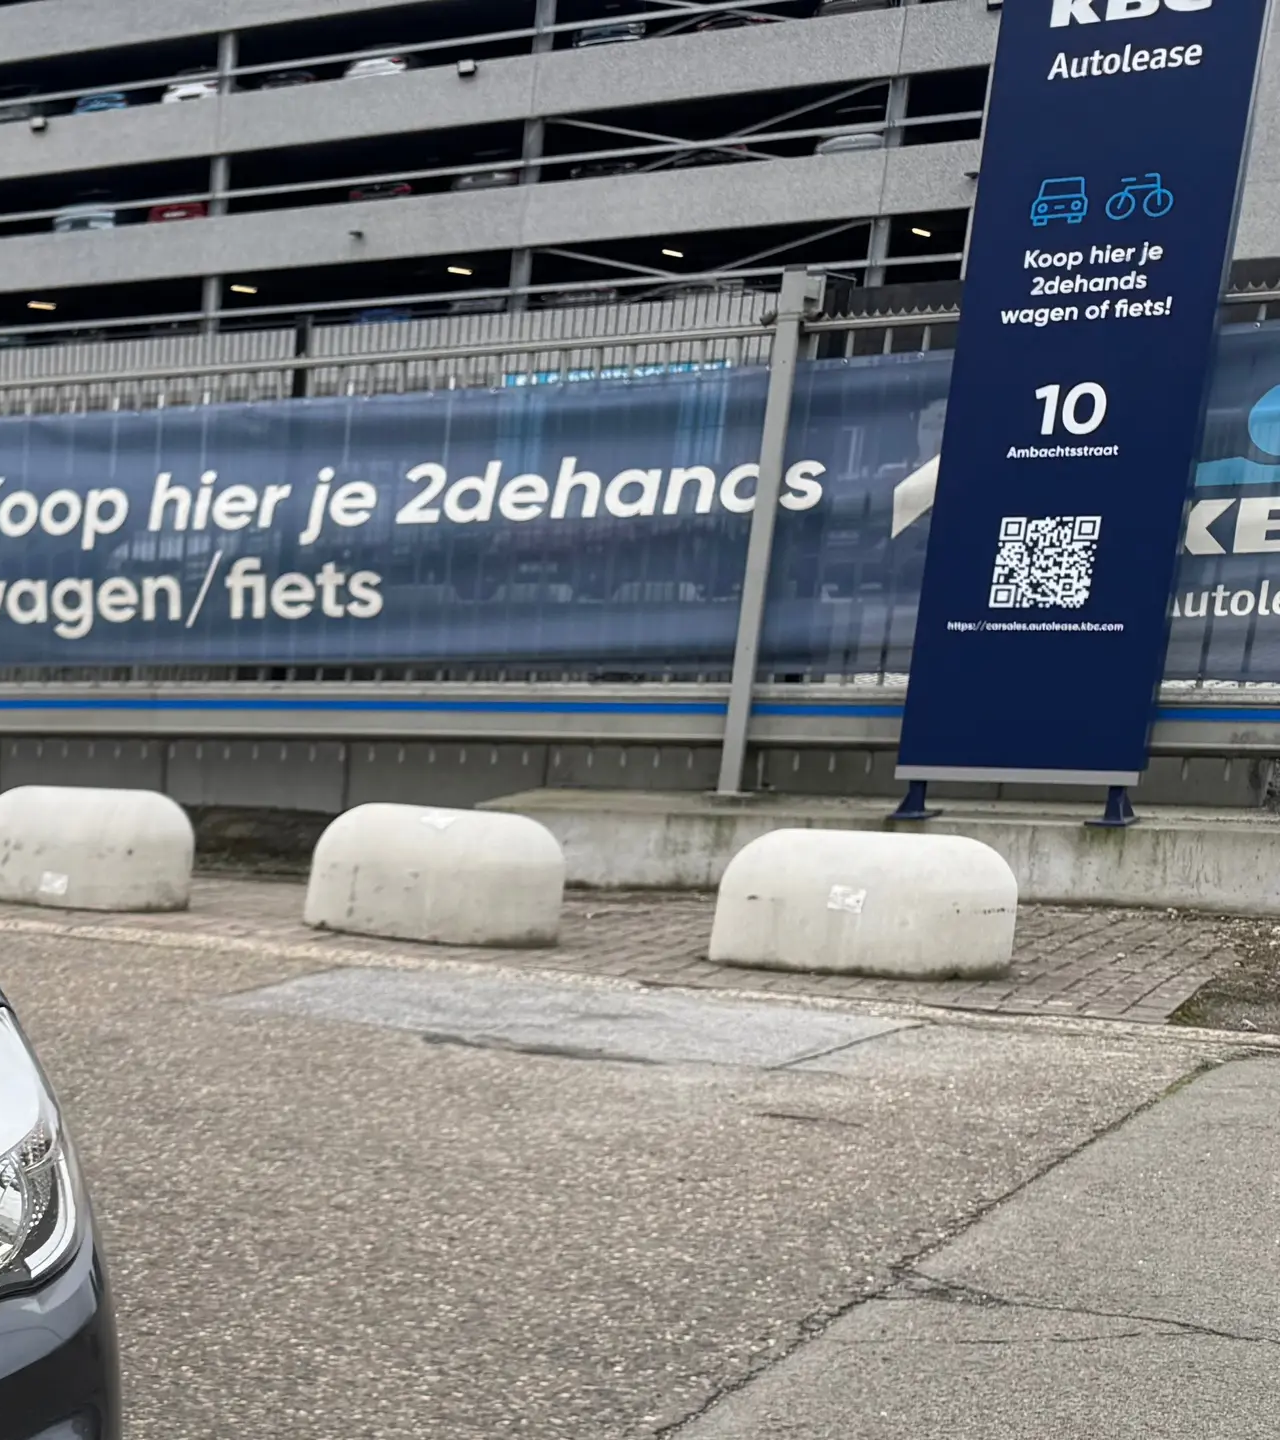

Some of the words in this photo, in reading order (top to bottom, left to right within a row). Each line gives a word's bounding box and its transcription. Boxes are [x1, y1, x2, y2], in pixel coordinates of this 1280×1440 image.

[1047, 43, 1203, 80] Autolease
[1024, 249, 1083, 271] Koop
[1090, 244, 1135, 264] hier
[1139, 241, 1164, 266] je
[1030, 271, 1147, 295] 2dehands
[1001, 306, 1078, 327] wagen
[1085, 299, 1110, 319] of
[1115, 296, 1173, 318] fiets!
[1035, 381, 1107, 435] 10
[1006, 445, 1119, 459] Ambachtsstraat
[147, 470, 292, 532] hier
[299, 467, 378, 546] je
